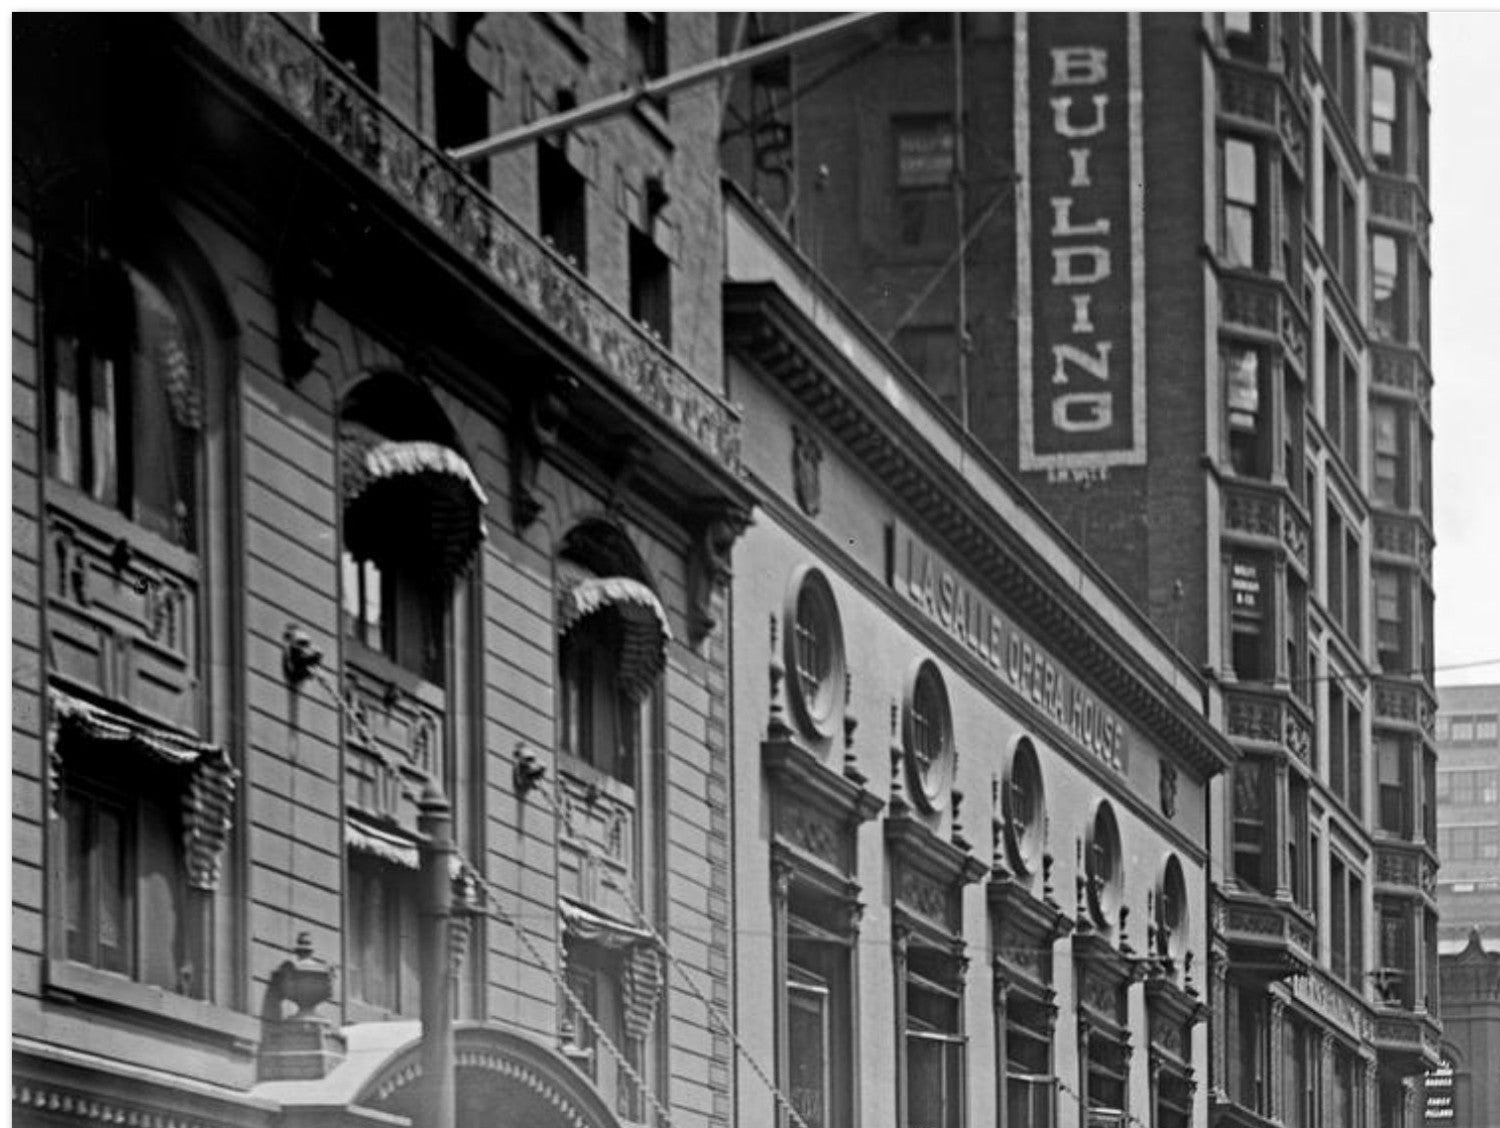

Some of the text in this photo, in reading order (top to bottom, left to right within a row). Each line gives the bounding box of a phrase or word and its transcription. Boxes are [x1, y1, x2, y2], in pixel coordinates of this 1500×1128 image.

[1049, 47, 1113, 432] BUILDING
[1006, 630, 1064, 725] OPERA
[1069, 684, 1121, 771] HOUSE
